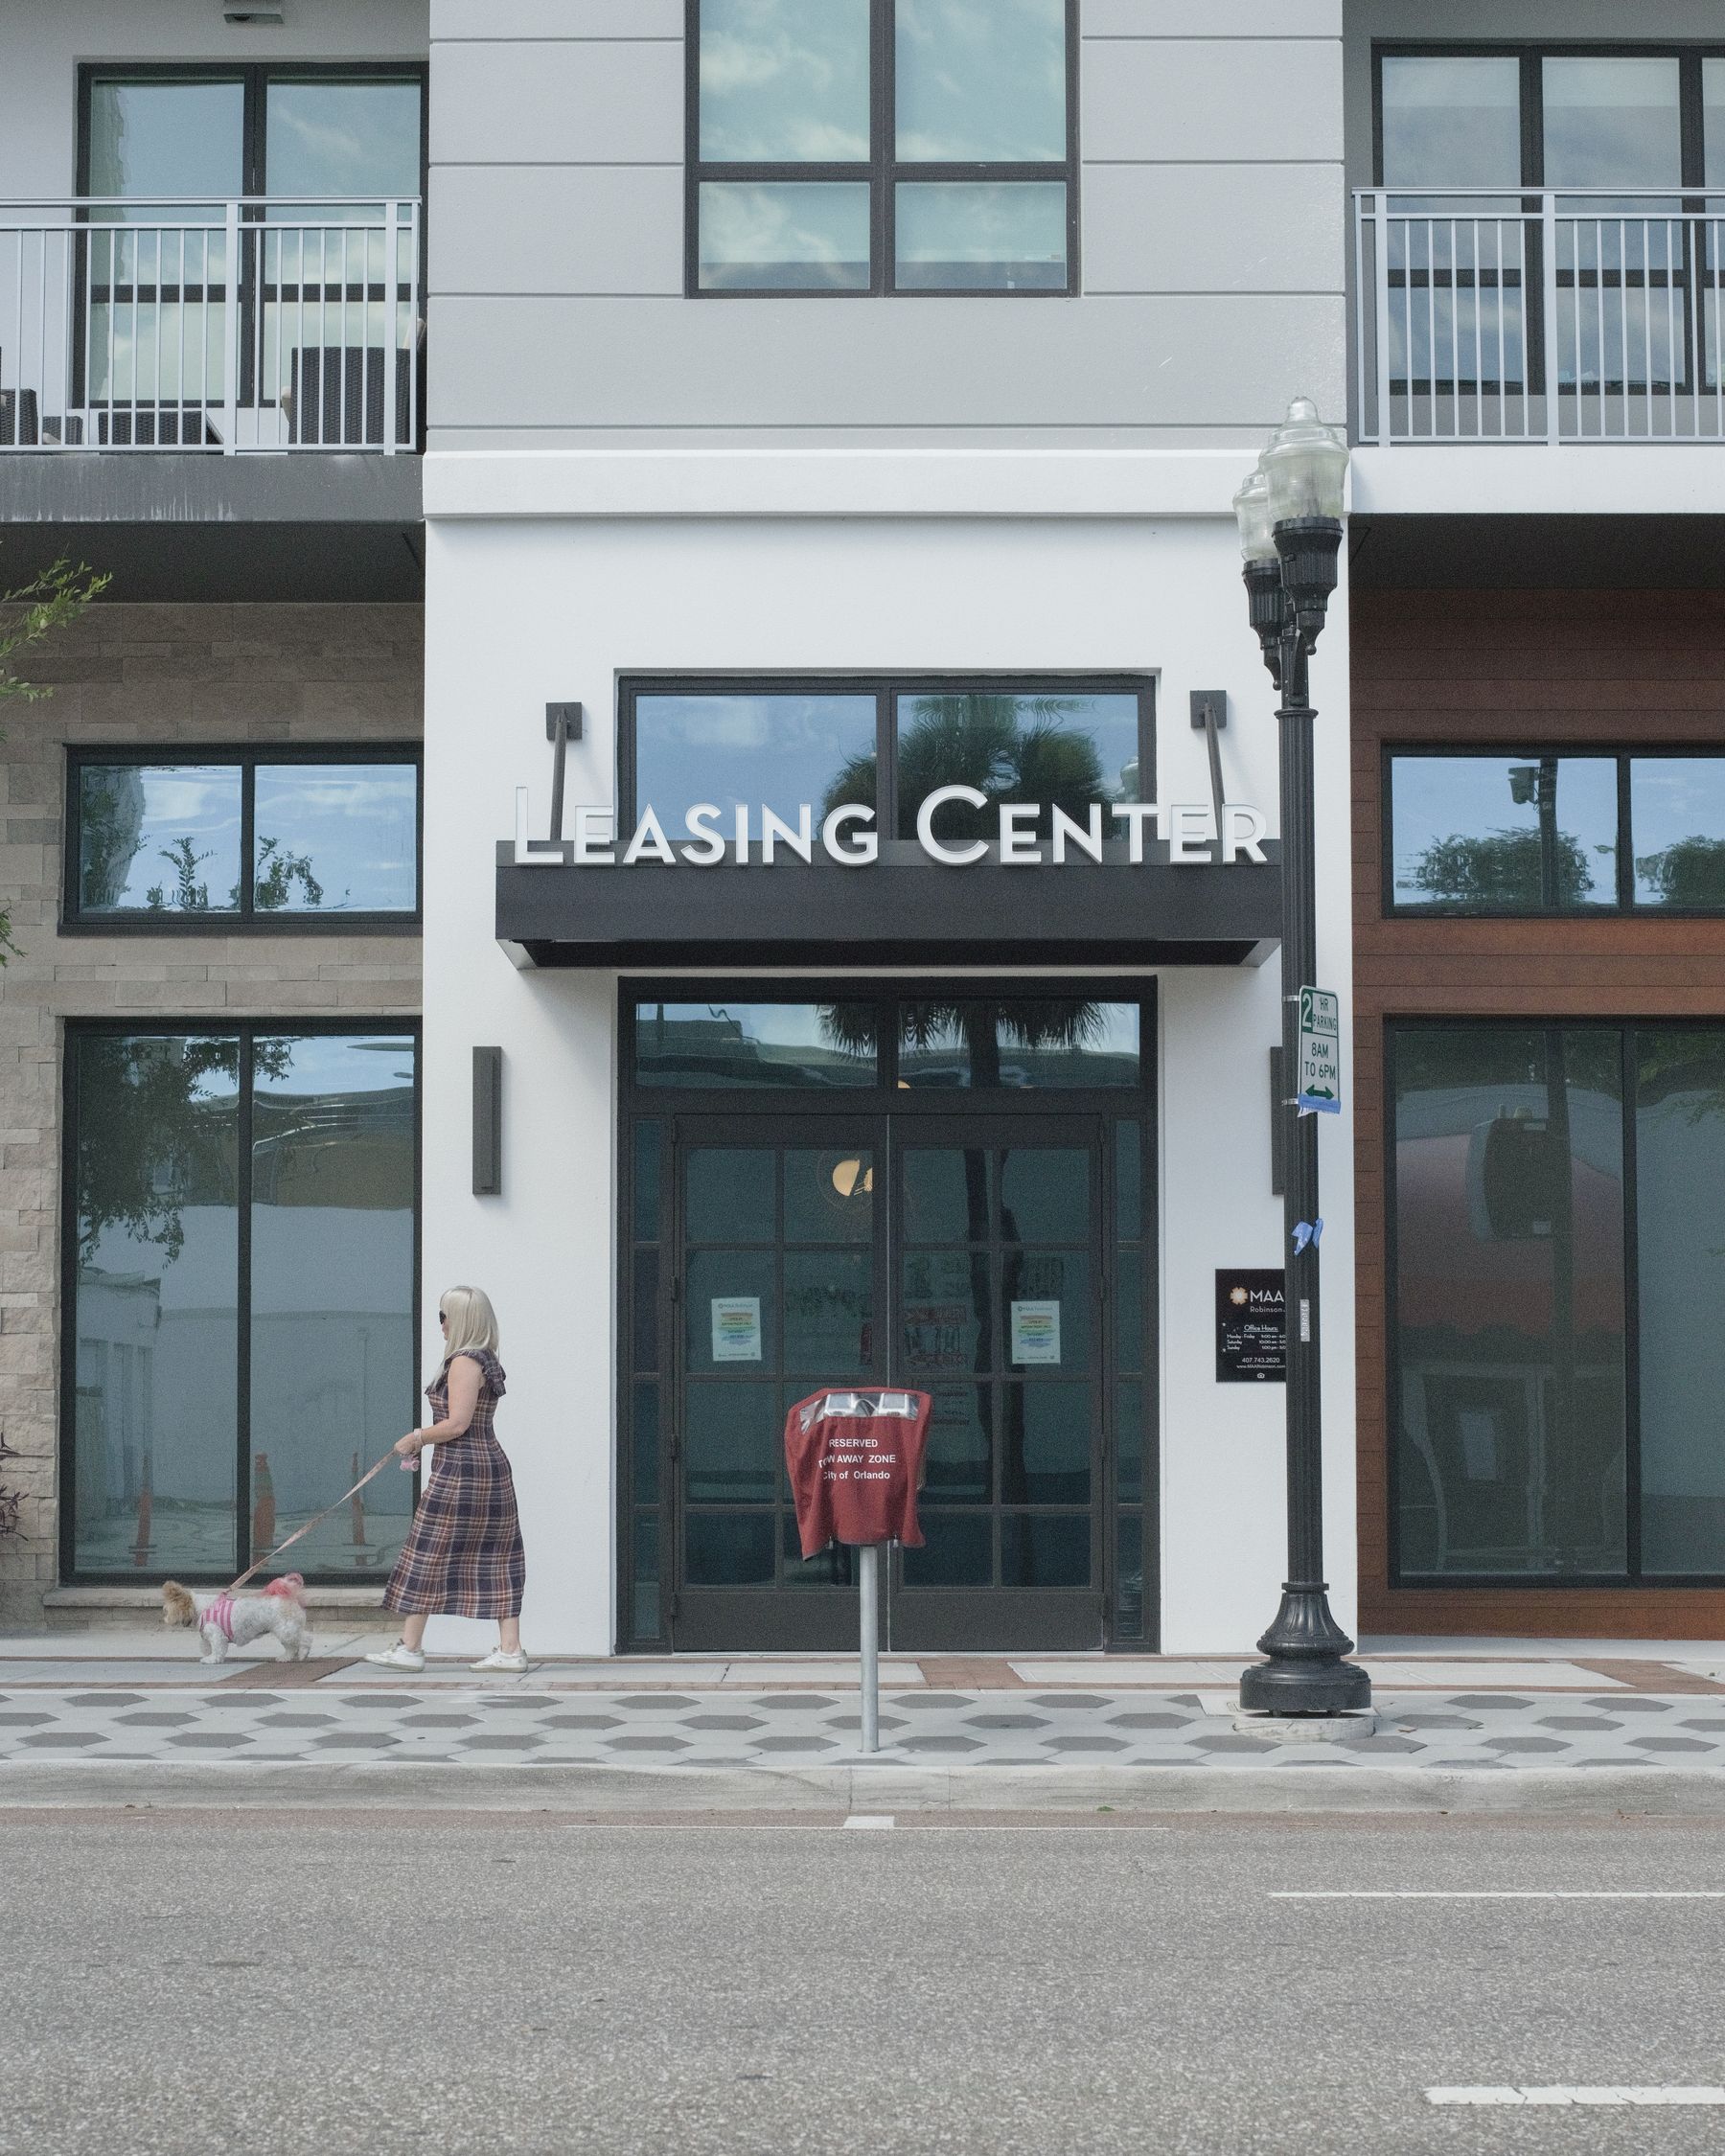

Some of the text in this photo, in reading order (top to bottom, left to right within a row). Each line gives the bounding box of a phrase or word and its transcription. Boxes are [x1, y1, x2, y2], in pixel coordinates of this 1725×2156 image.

[516, 784, 1269, 867] LEASING CENTER
[1301, 993, 1312, 1028] 2
[1320, 998, 1329, 1012] HR
[1313, 1014, 1338, 1031] PARKING
[1311, 1043, 1329, 1059] 8AM
[1304, 1061, 1337, 1080] TO 6PM
[1250, 1290, 1284, 1302] MAA
[829, 1438, 878, 1448] RESERVED
[837, 1455, 863, 1463] AWAY
[868, 1455, 896, 1463] ZONE
[839, 1471, 848, 1479] of
[854, 1471, 890, 1479] Orlando
